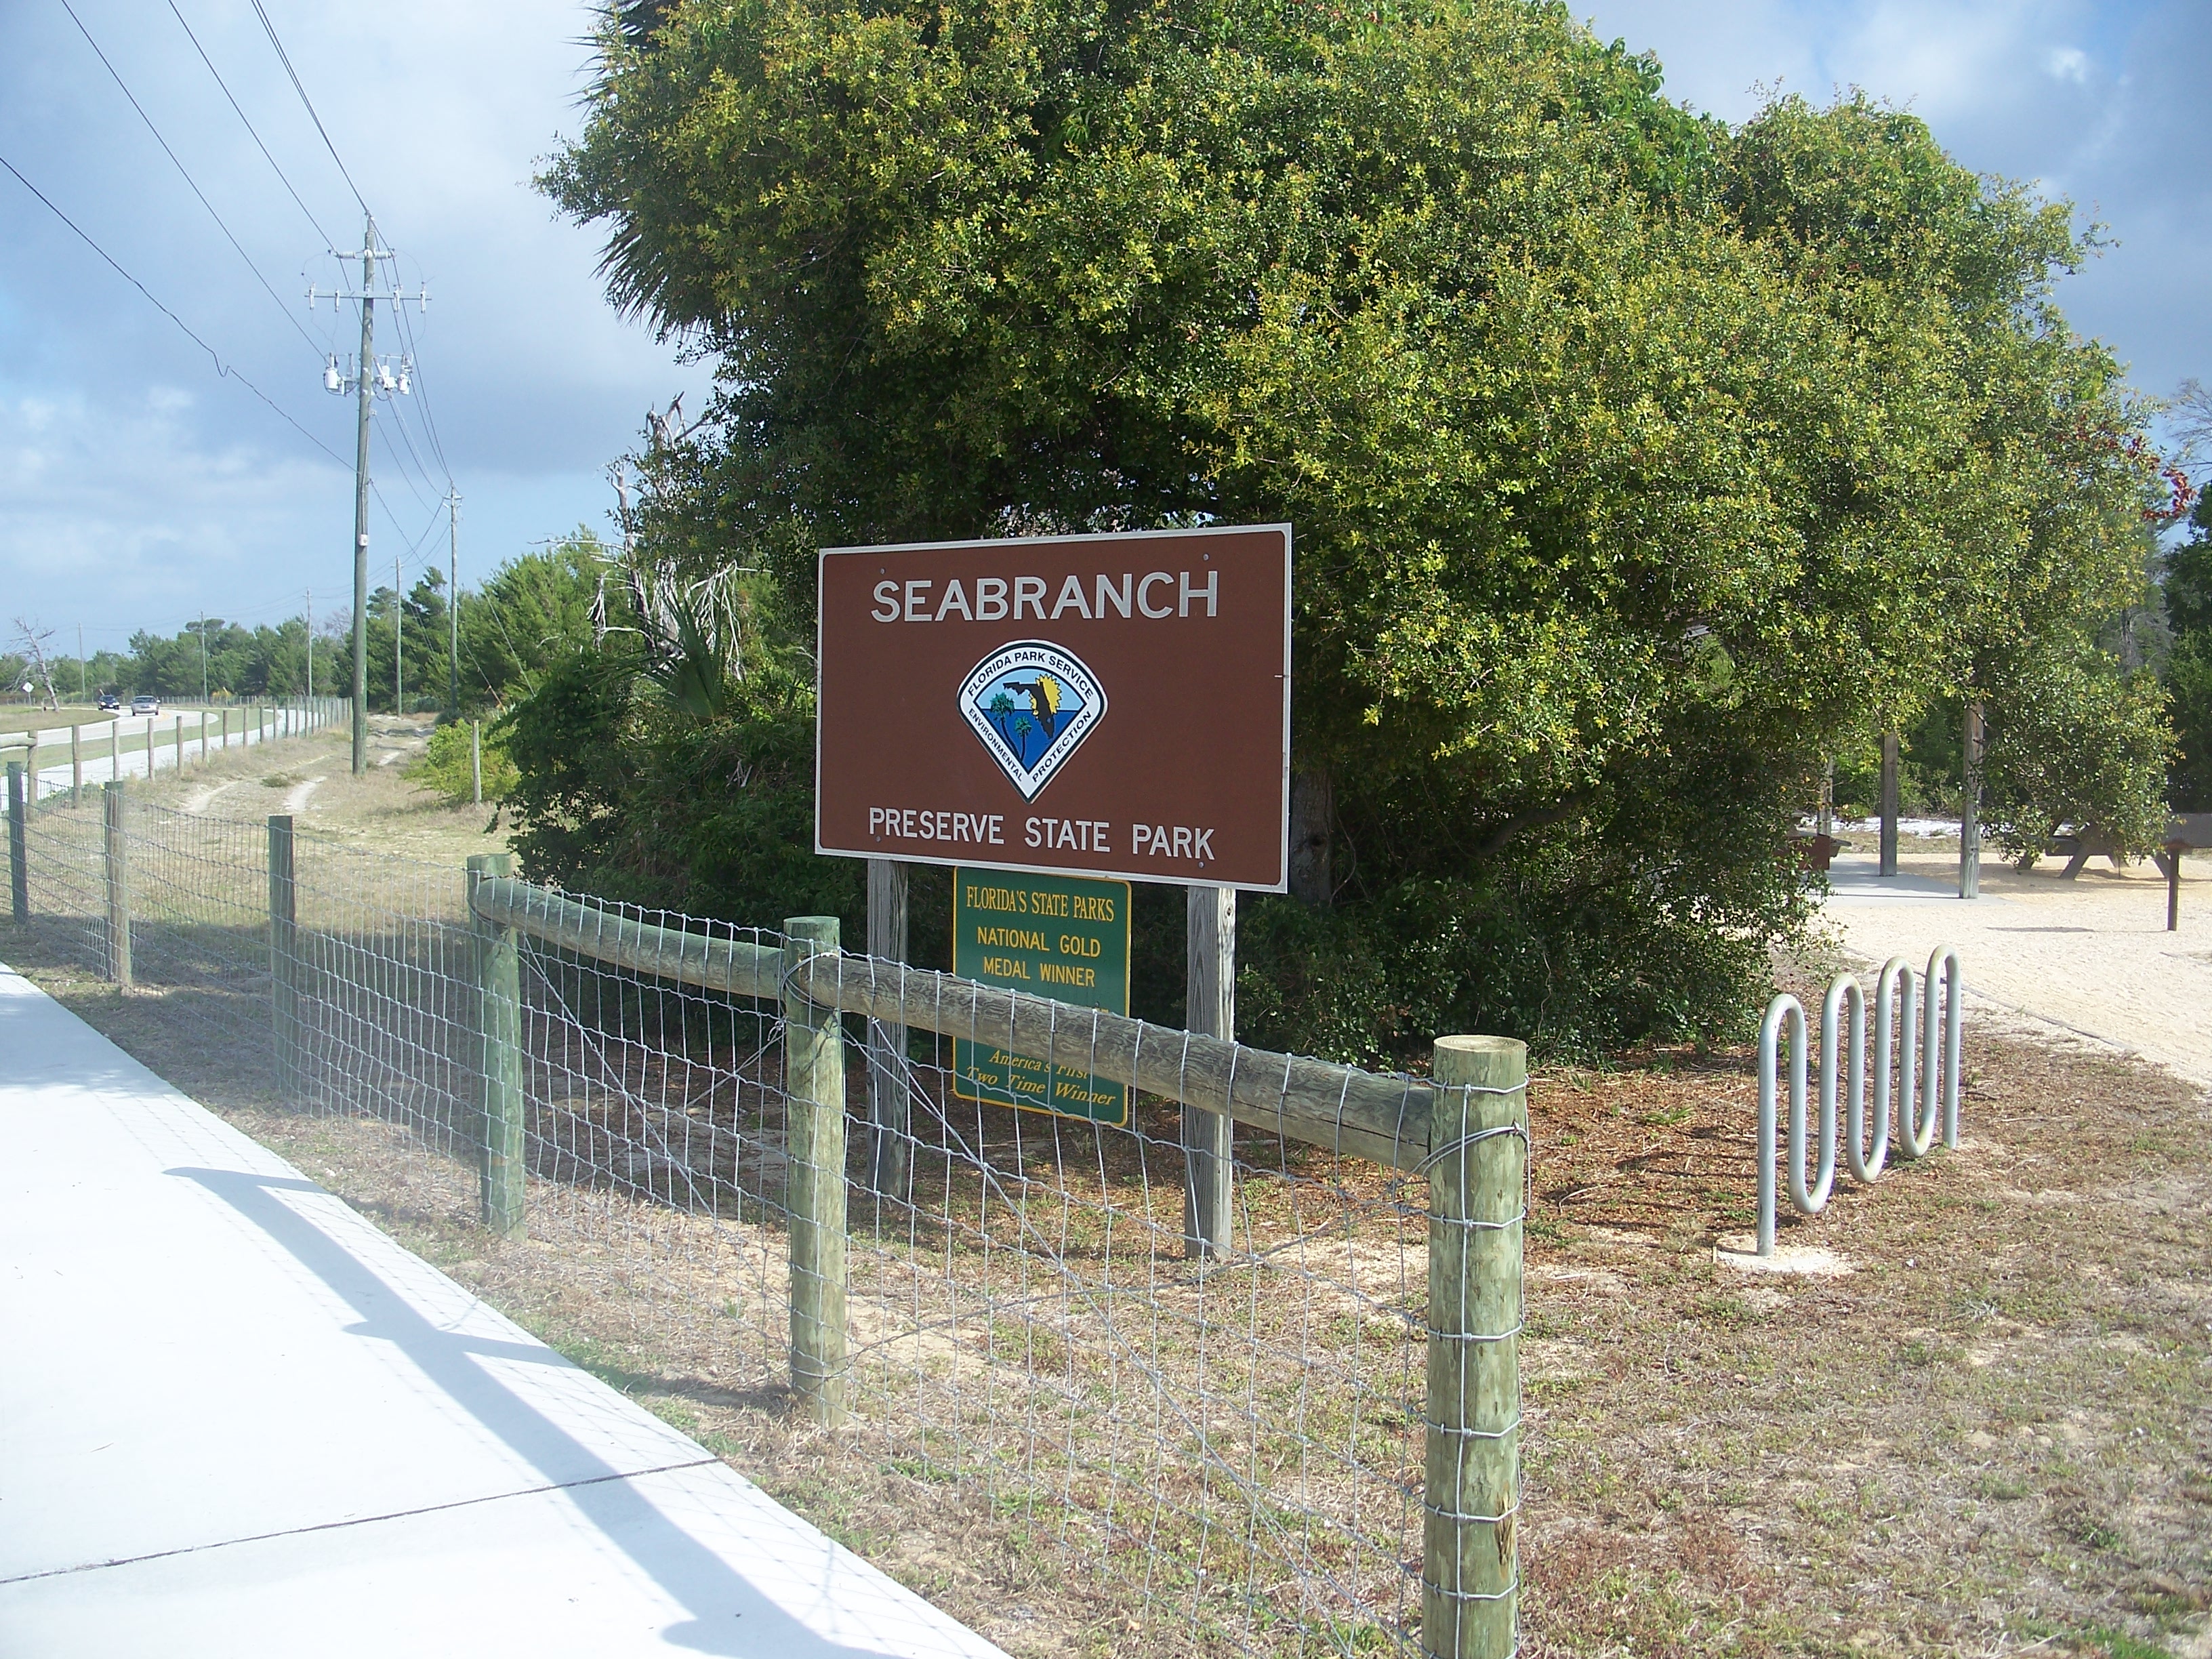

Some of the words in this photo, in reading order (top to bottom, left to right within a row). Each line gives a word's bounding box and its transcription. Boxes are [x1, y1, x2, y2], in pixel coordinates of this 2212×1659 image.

[871, 571, 1218, 623] SEABRANCH
[968, 655, 1012, 697] FLORIDA
[1015, 651, 1046, 663] PARK
[1048, 655, 1094, 699] SERVICE
[968, 708, 1023, 782] ENVIRONMENTAL
[1032, 711, 1092, 783] PROTECTION
[869, 807, 1005, 845] PRESERVE
[1024, 817, 1111, 853] STATE
[1132, 824, 1215, 860] PARK
[966, 885, 1027, 914] FLORIDA'S
[1031, 892, 1069, 918] STATE
[1073, 895, 1115, 922] PARKS
[977, 926, 1050, 951] NATIONAL
[1060, 935, 1101, 958] GOLD
[984, 956, 1031, 980] MEDAL
[1040, 962, 1095, 987] WINNER
[989, 1050, 1050, 1073] Americas
[967, 1066, 998, 1086] Two
[1007, 1074, 1046, 1094] Time
[1054, 1082, 1116, 1106] Winner
